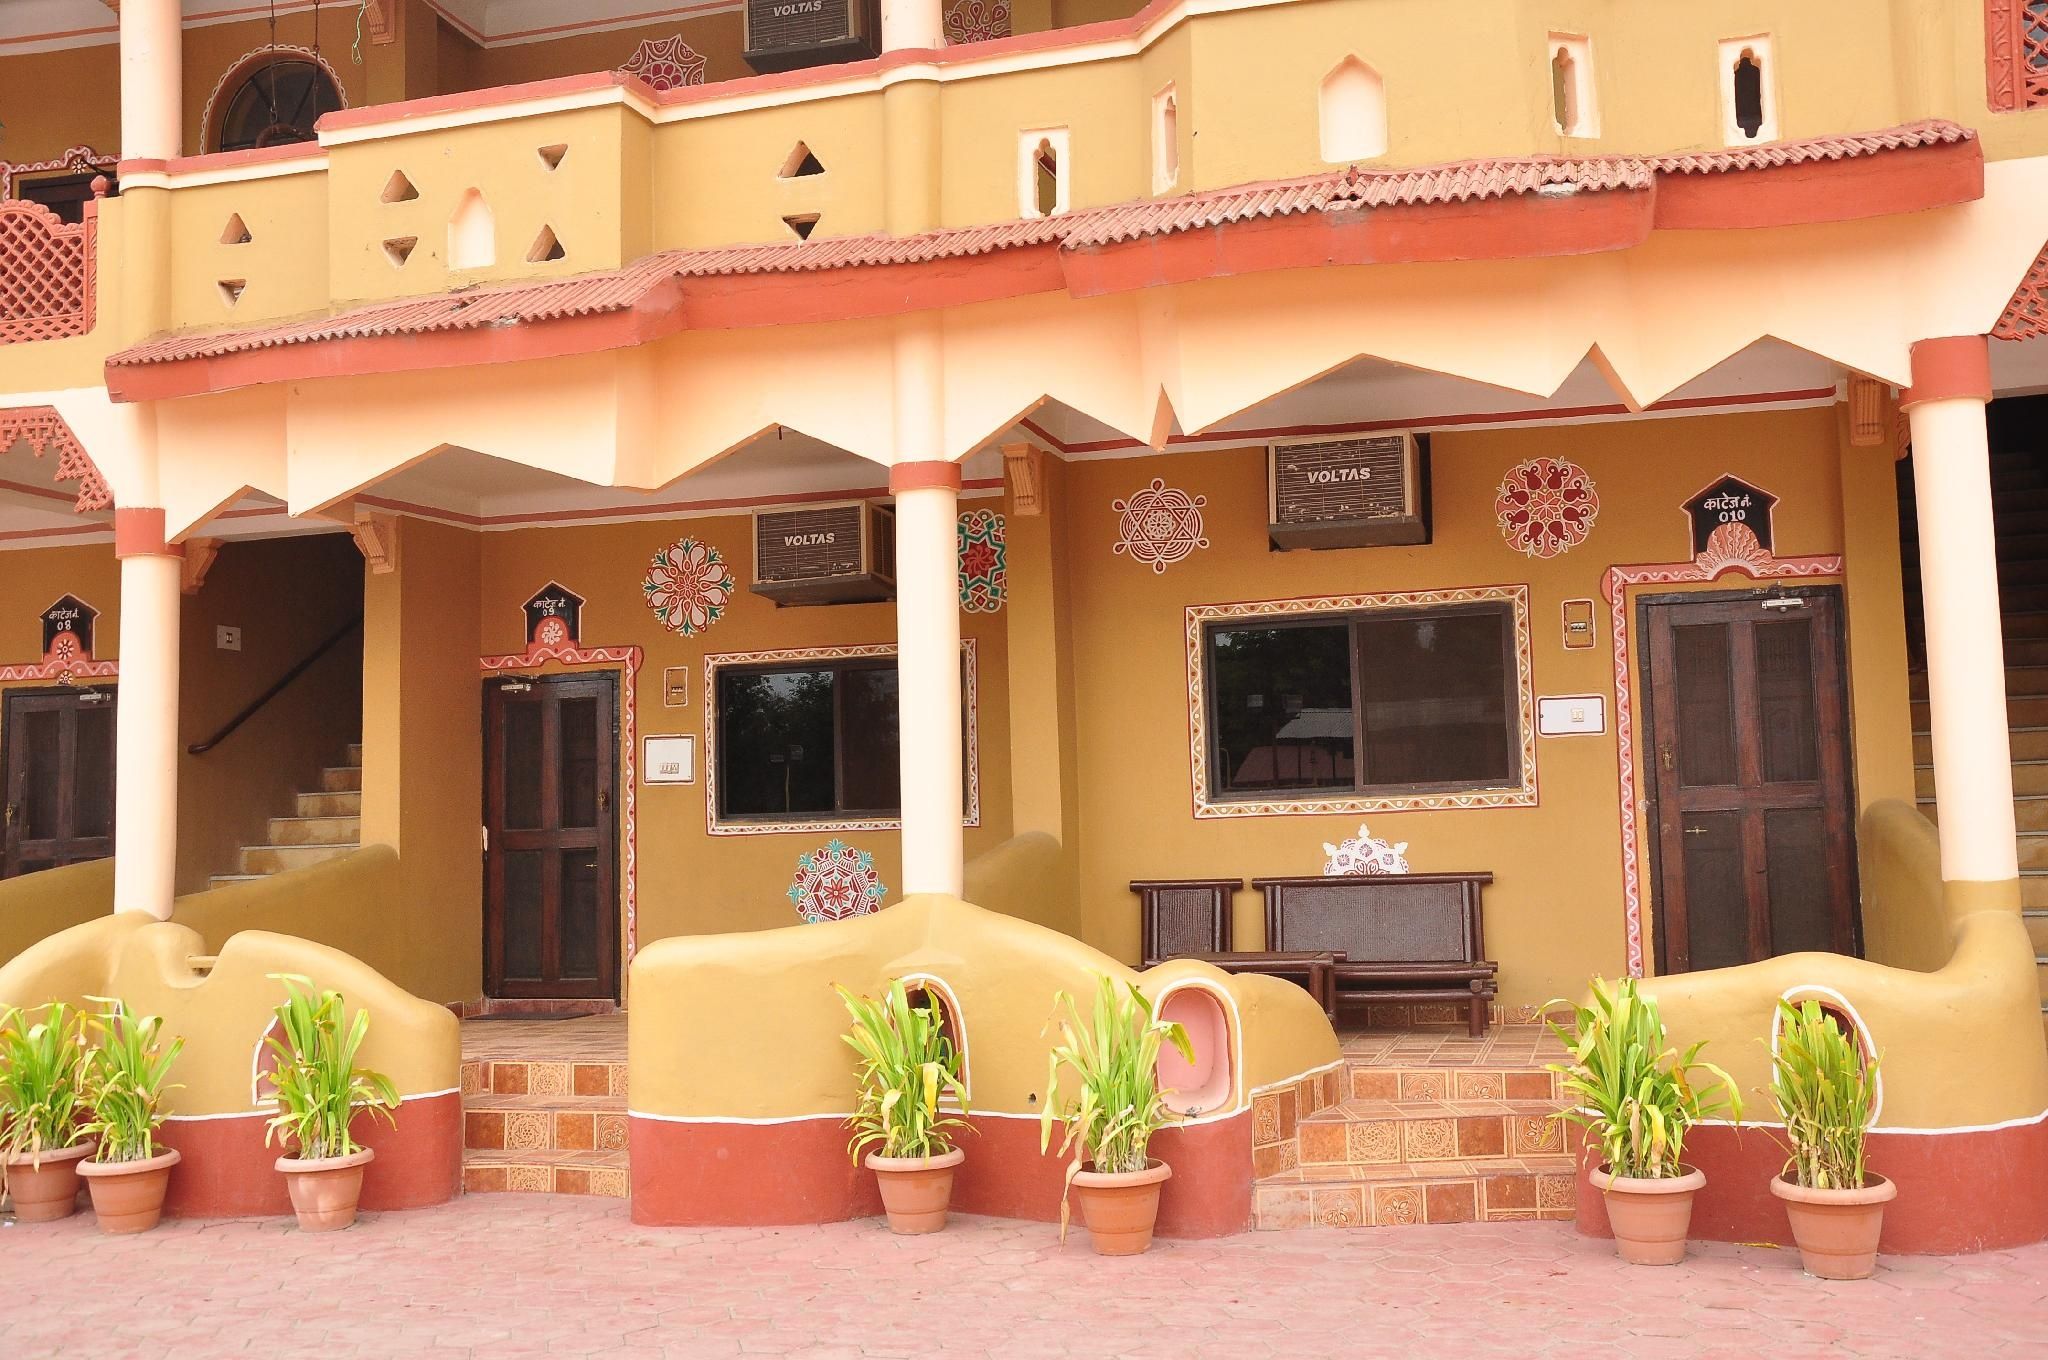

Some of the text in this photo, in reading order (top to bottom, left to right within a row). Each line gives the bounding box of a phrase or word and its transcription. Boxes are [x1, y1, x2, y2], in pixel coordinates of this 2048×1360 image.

[773, 1, 822, 17] VOLTAS
[1307, 467, 1371, 484] VOLTAS
[1703, 492, 1740, 511] काटेज
[1718, 509, 1746, 523] 010
[784, 532, 835, 547] VOLTAS
[542, 607, 555, 617] 09
[56, 619, 72, 631] 08
